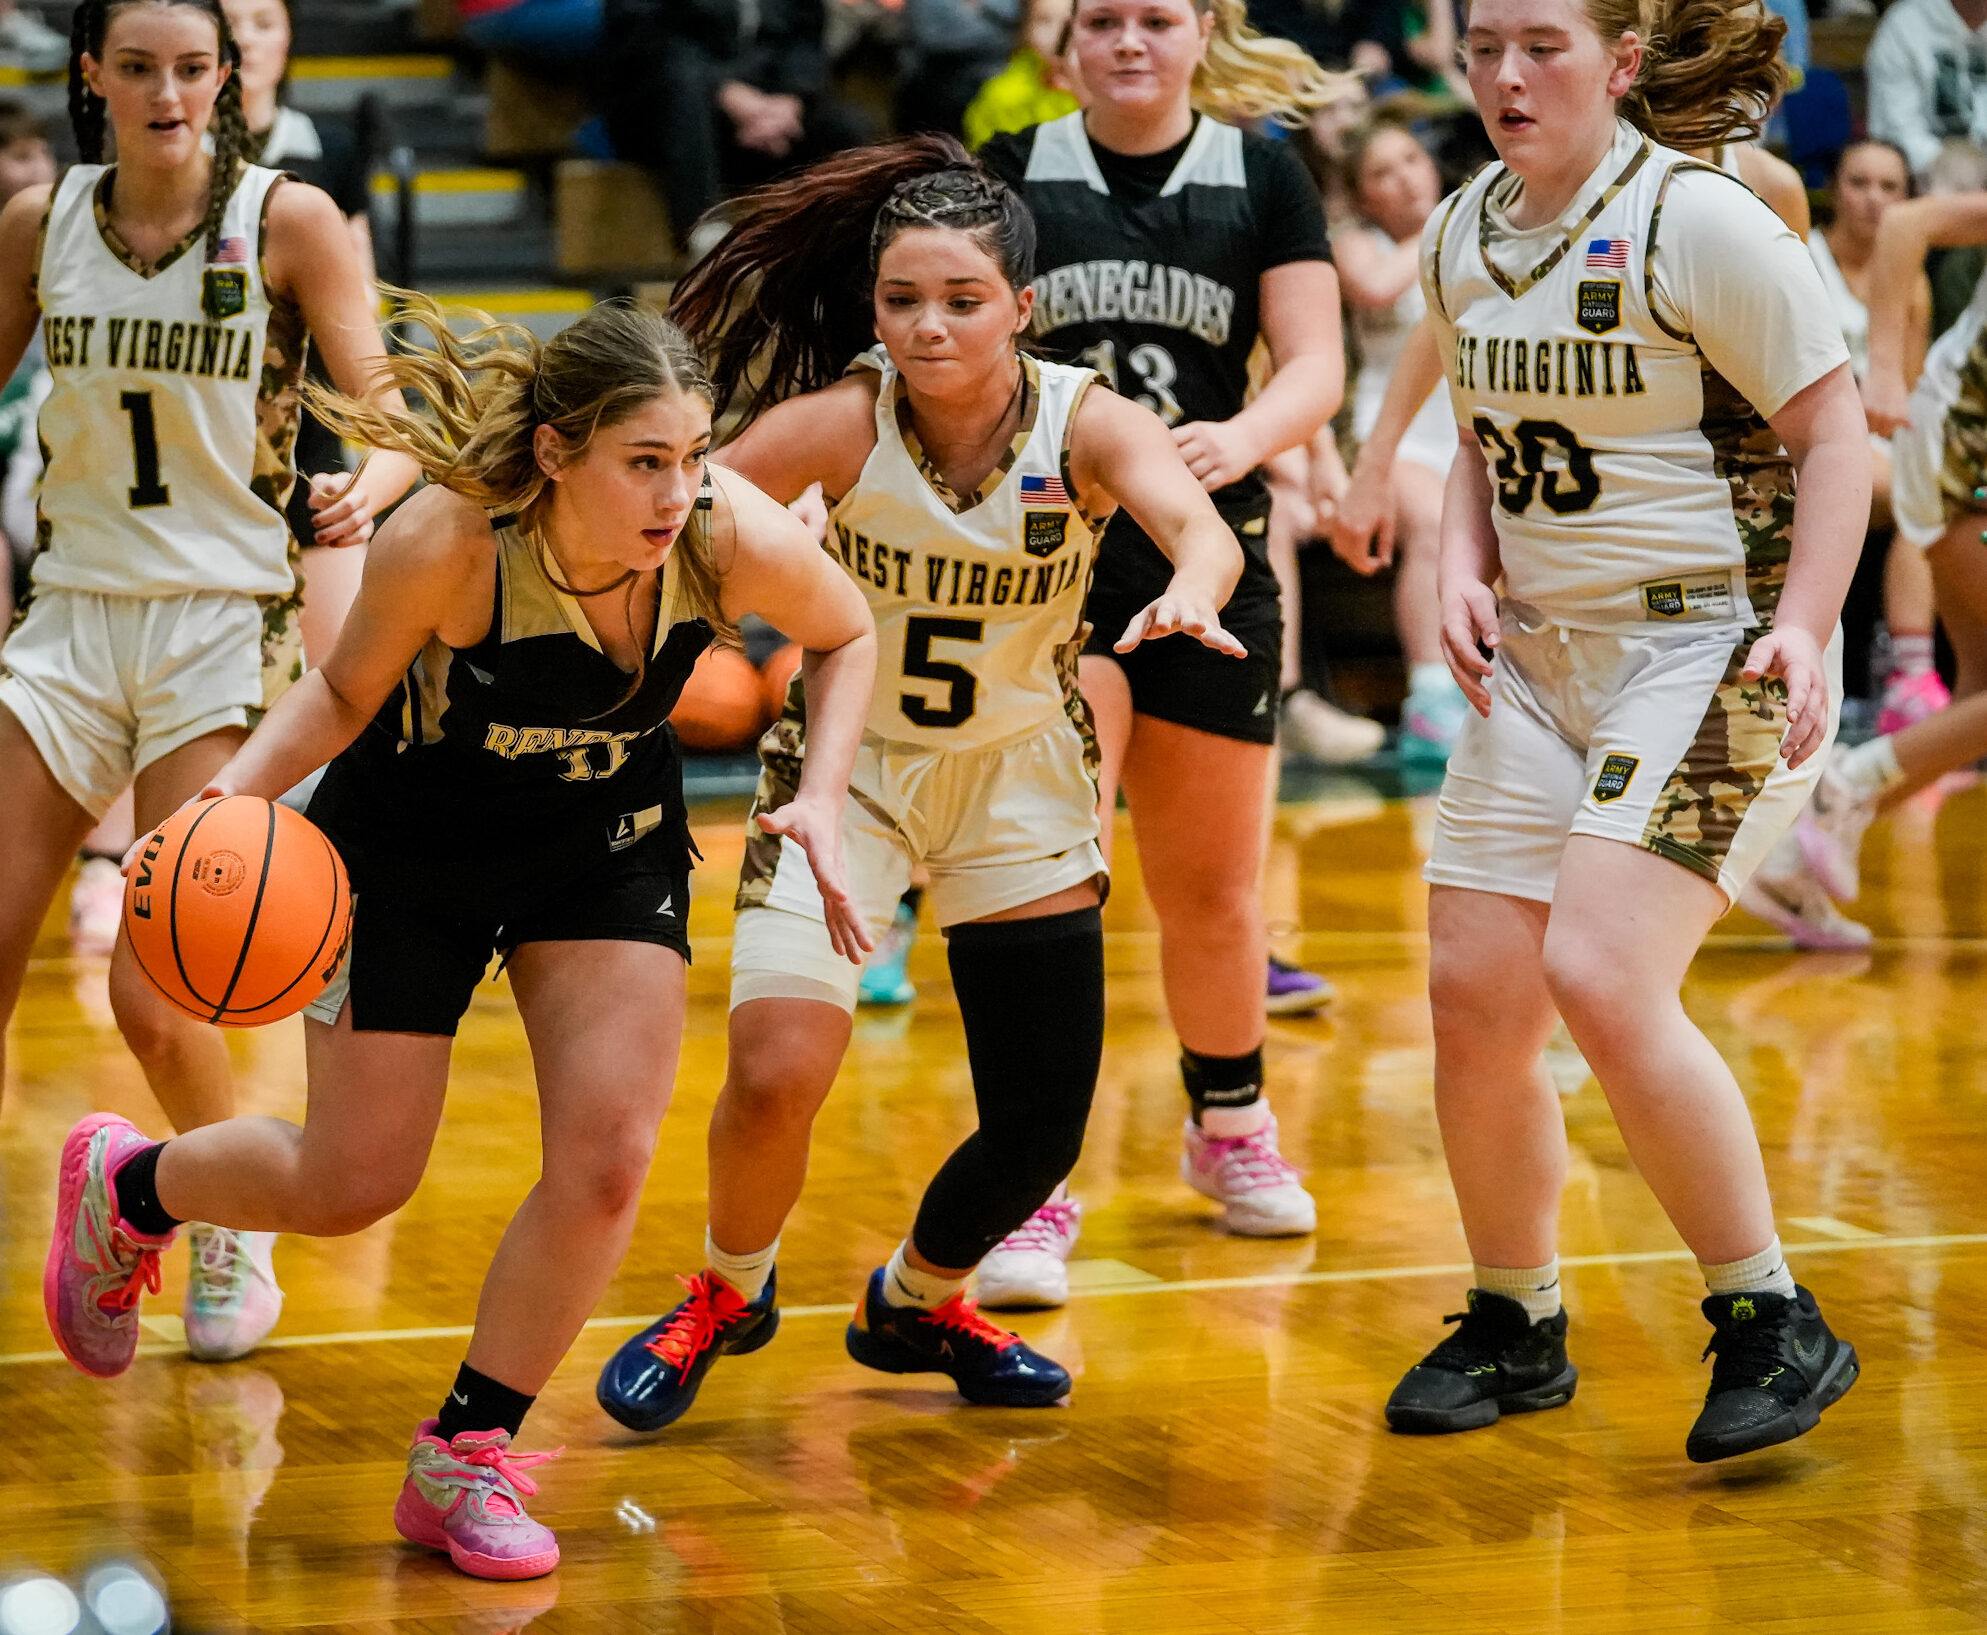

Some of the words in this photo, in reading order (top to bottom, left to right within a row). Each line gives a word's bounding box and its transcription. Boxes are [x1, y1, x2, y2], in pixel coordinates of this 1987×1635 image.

[1582, 307, 1616, 318] GUARD
[1583, 291, 1614, 301] ARMY
[45, 316, 96, 367] EST
[106, 317, 252, 381] VIRGINIA
[1486, 336, 1646, 396] VIRGINIA
[120, 389, 172, 509] 1
[1472, 416, 1601, 516] 30
[1029, 532, 1063, 545] GUARD
[925, 551, 1081, 607] VIRGINIA
[900, 613, 984, 728] 5
[1604, 764, 1631, 774] ARMY
